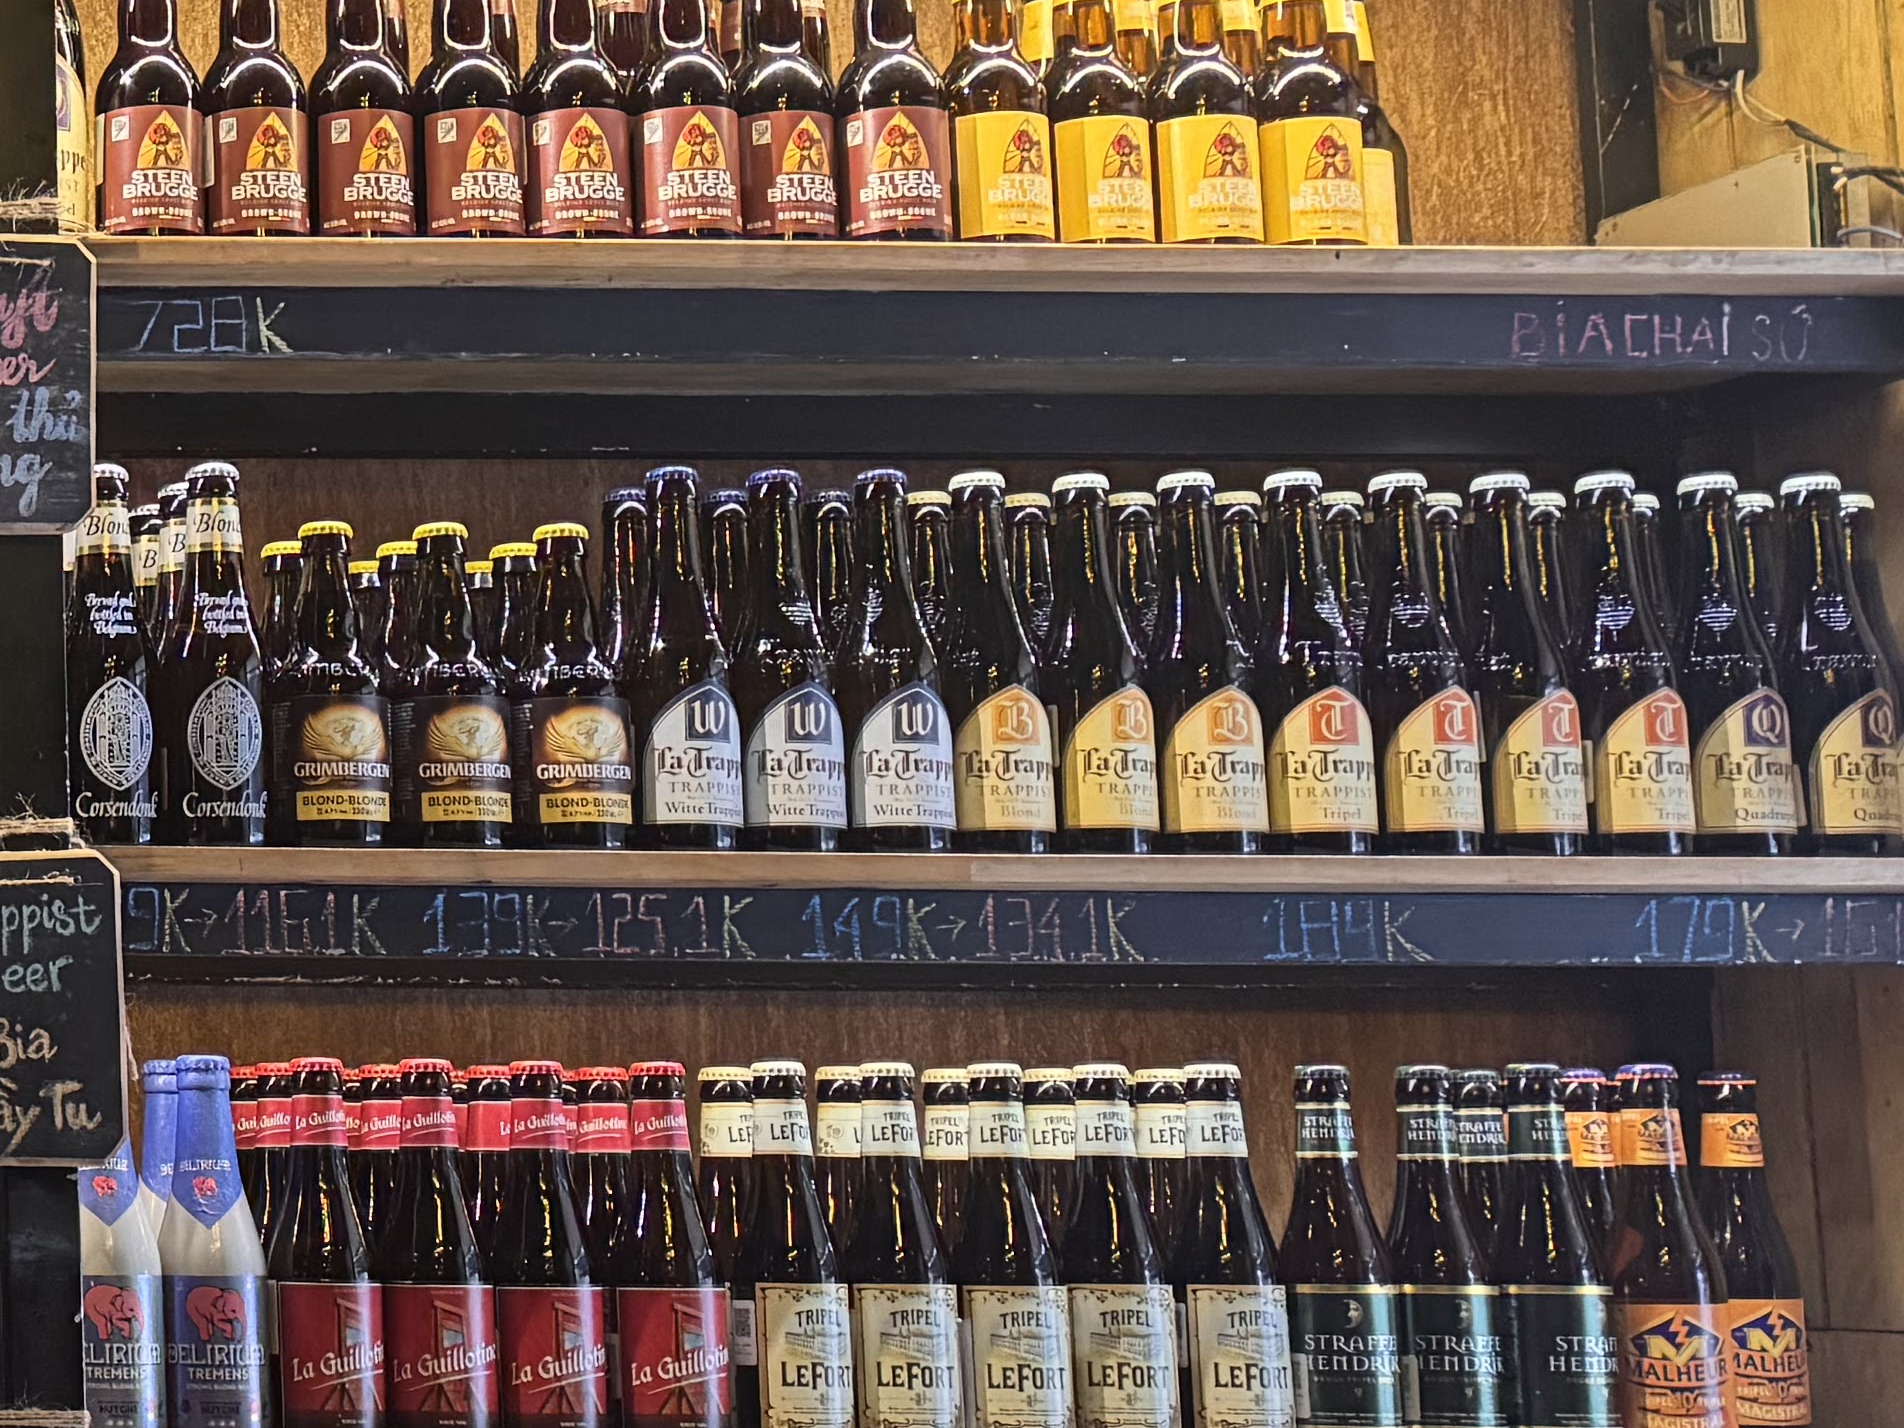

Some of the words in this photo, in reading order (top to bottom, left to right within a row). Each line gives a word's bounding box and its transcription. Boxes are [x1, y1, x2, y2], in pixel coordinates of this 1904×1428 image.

[131, 169, 193, 188] STEEN
[459, 172, 520, 189] STEEN
[667, 170, 729, 188] STEEN
[123, 183, 198, 203] BRUGGE
[452, 186, 522, 205] BRUGGE
[658, 184, 736, 203] BRUGGE
[294, 760, 390, 780] GRIMBERGEN
[419, 760, 512, 779] GRIMBERGEN
[183, 790, 266, 820] Corsendonk
[40, 1078, 101, 1132] Tu
[888, 1307, 941, 1330] TRIPEL
